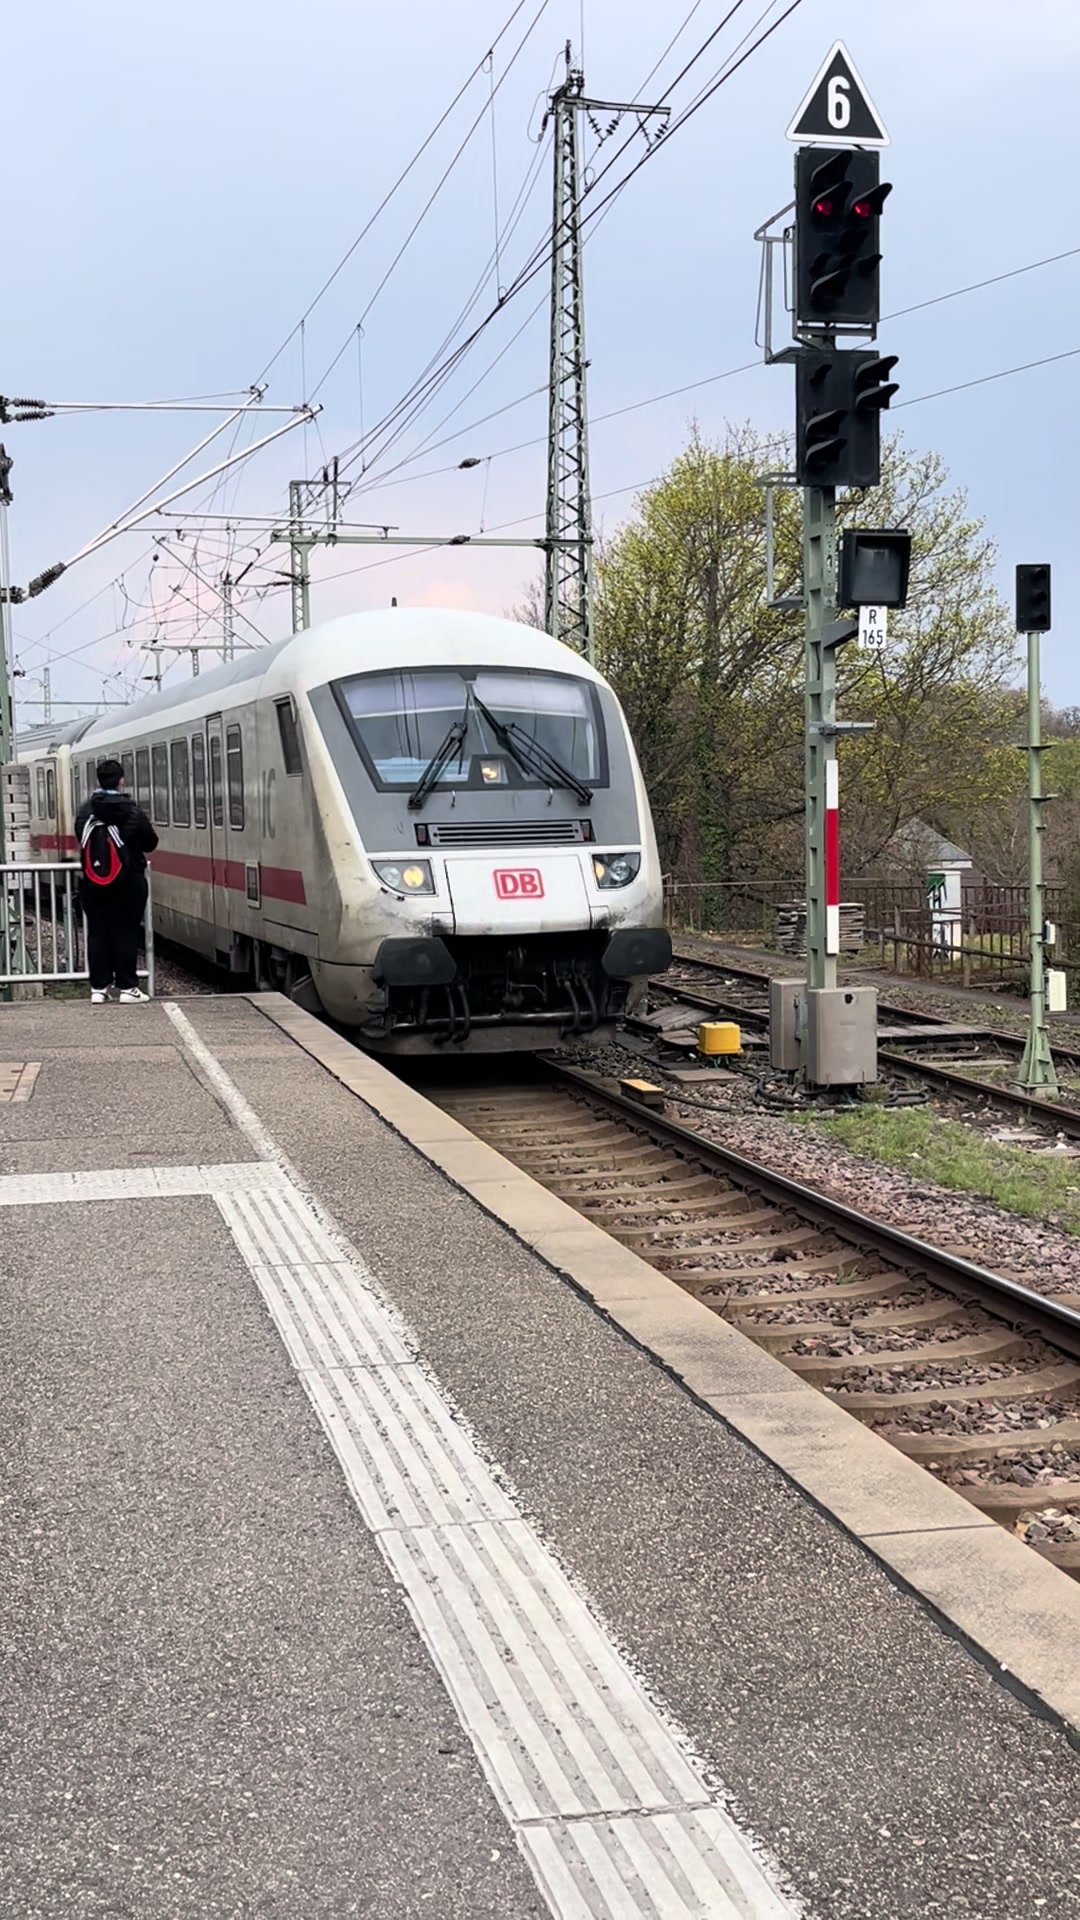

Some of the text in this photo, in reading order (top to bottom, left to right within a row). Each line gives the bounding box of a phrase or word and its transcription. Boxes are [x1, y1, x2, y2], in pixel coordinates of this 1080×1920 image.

[828, 75, 850, 130] 6
[868, 608, 878, 625] R
[862, 629, 884, 646] 165
[262, 767, 277, 840] IC
[499, 873, 538, 894] DB
